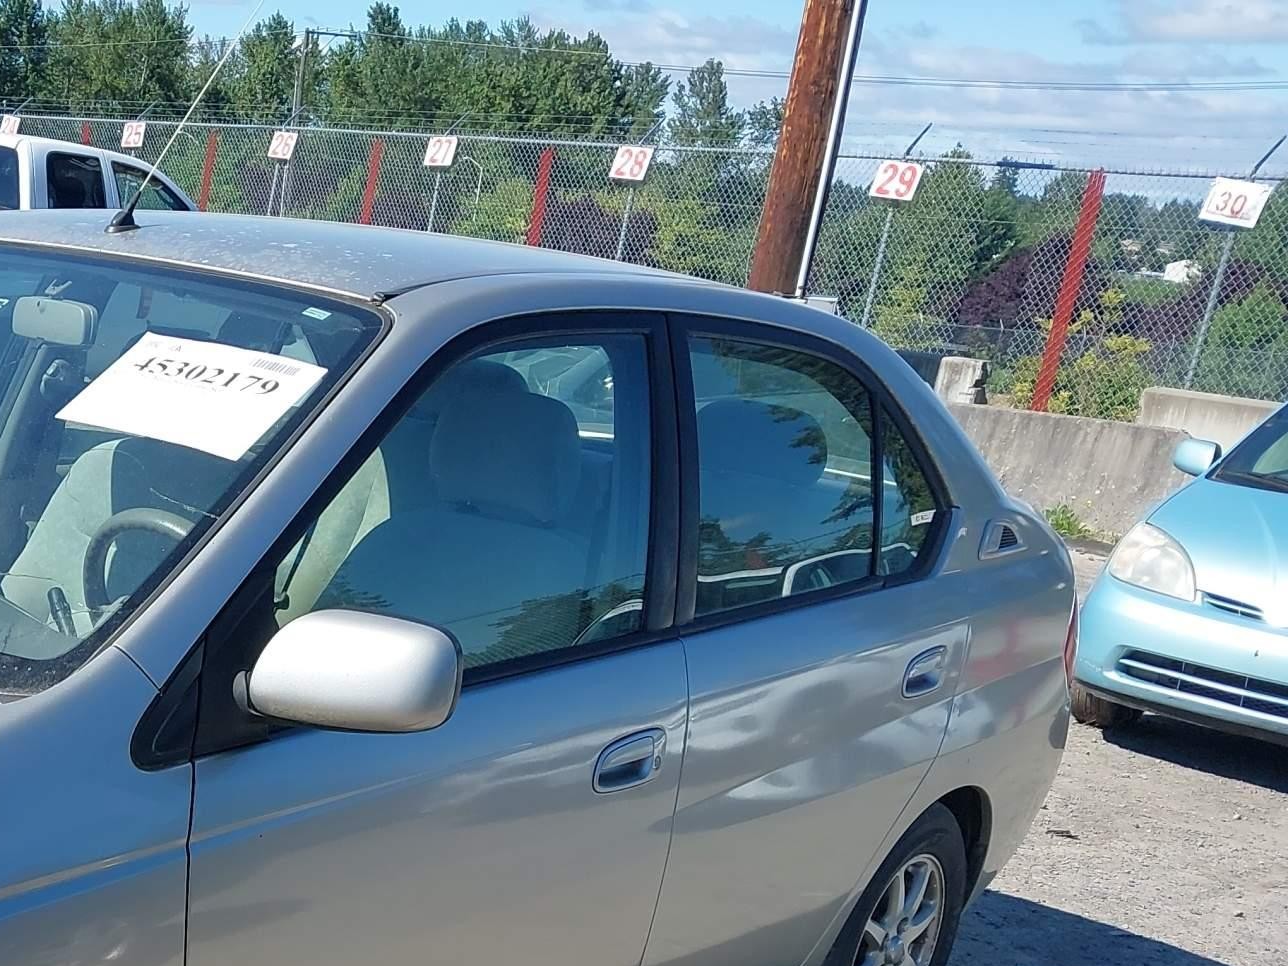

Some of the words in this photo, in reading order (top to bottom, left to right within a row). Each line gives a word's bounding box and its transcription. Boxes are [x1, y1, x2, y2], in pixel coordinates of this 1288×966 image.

[123, 124, 142, 145] 25
[270, 134, 293, 156] 26
[429, 138, 452, 163] 27
[615, 149, 647, 177] 28
[875, 164, 917, 197] 29
[1216, 192, 1247, 215] 30
[134, 357, 279, 394] 45302179
